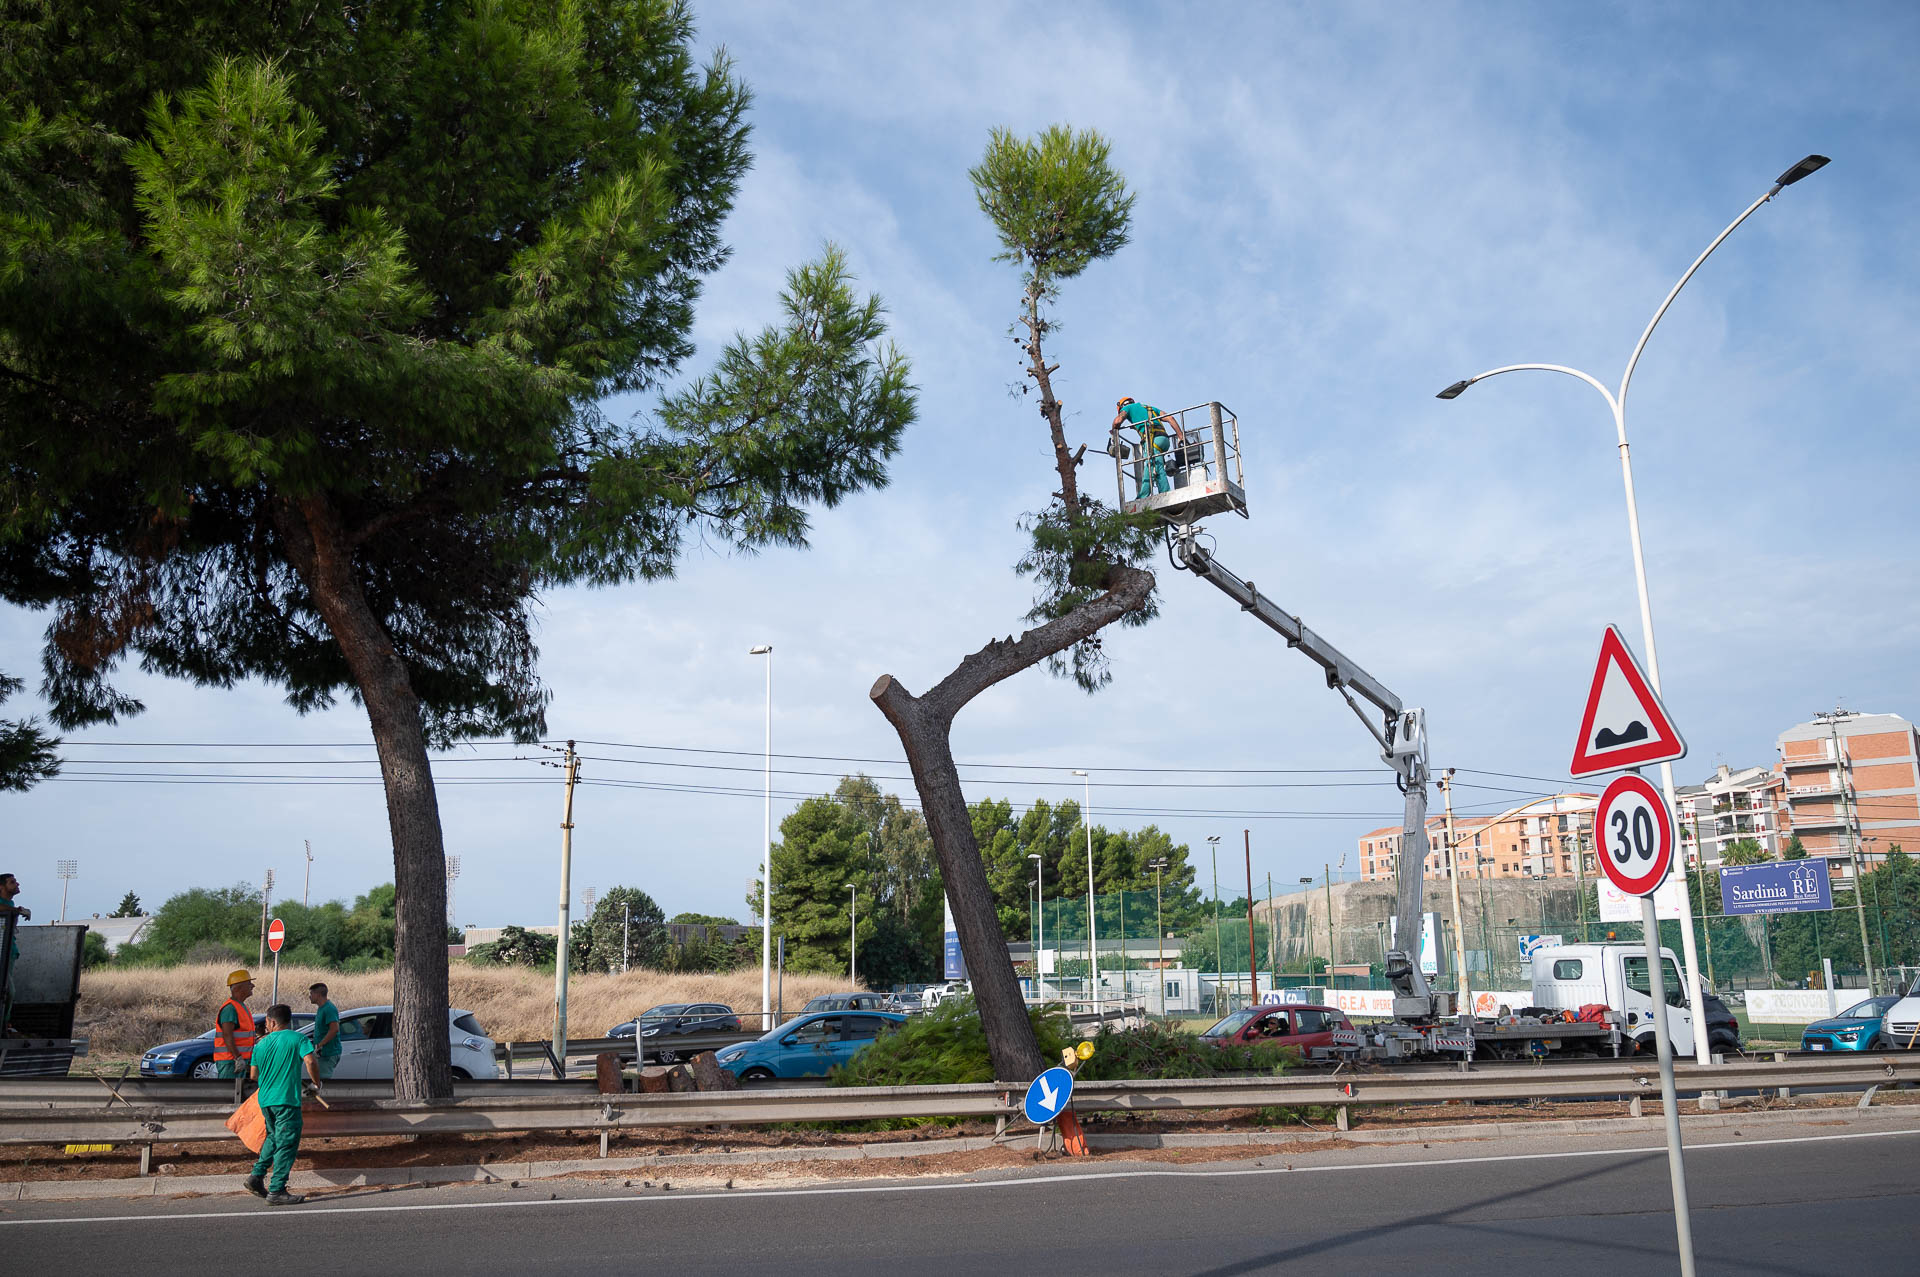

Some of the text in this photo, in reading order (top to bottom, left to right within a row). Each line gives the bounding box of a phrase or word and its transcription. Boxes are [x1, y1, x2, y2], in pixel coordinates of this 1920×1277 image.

[1611, 806, 1654, 863] 30
[1732, 878, 1817, 900] Sardinia RE
